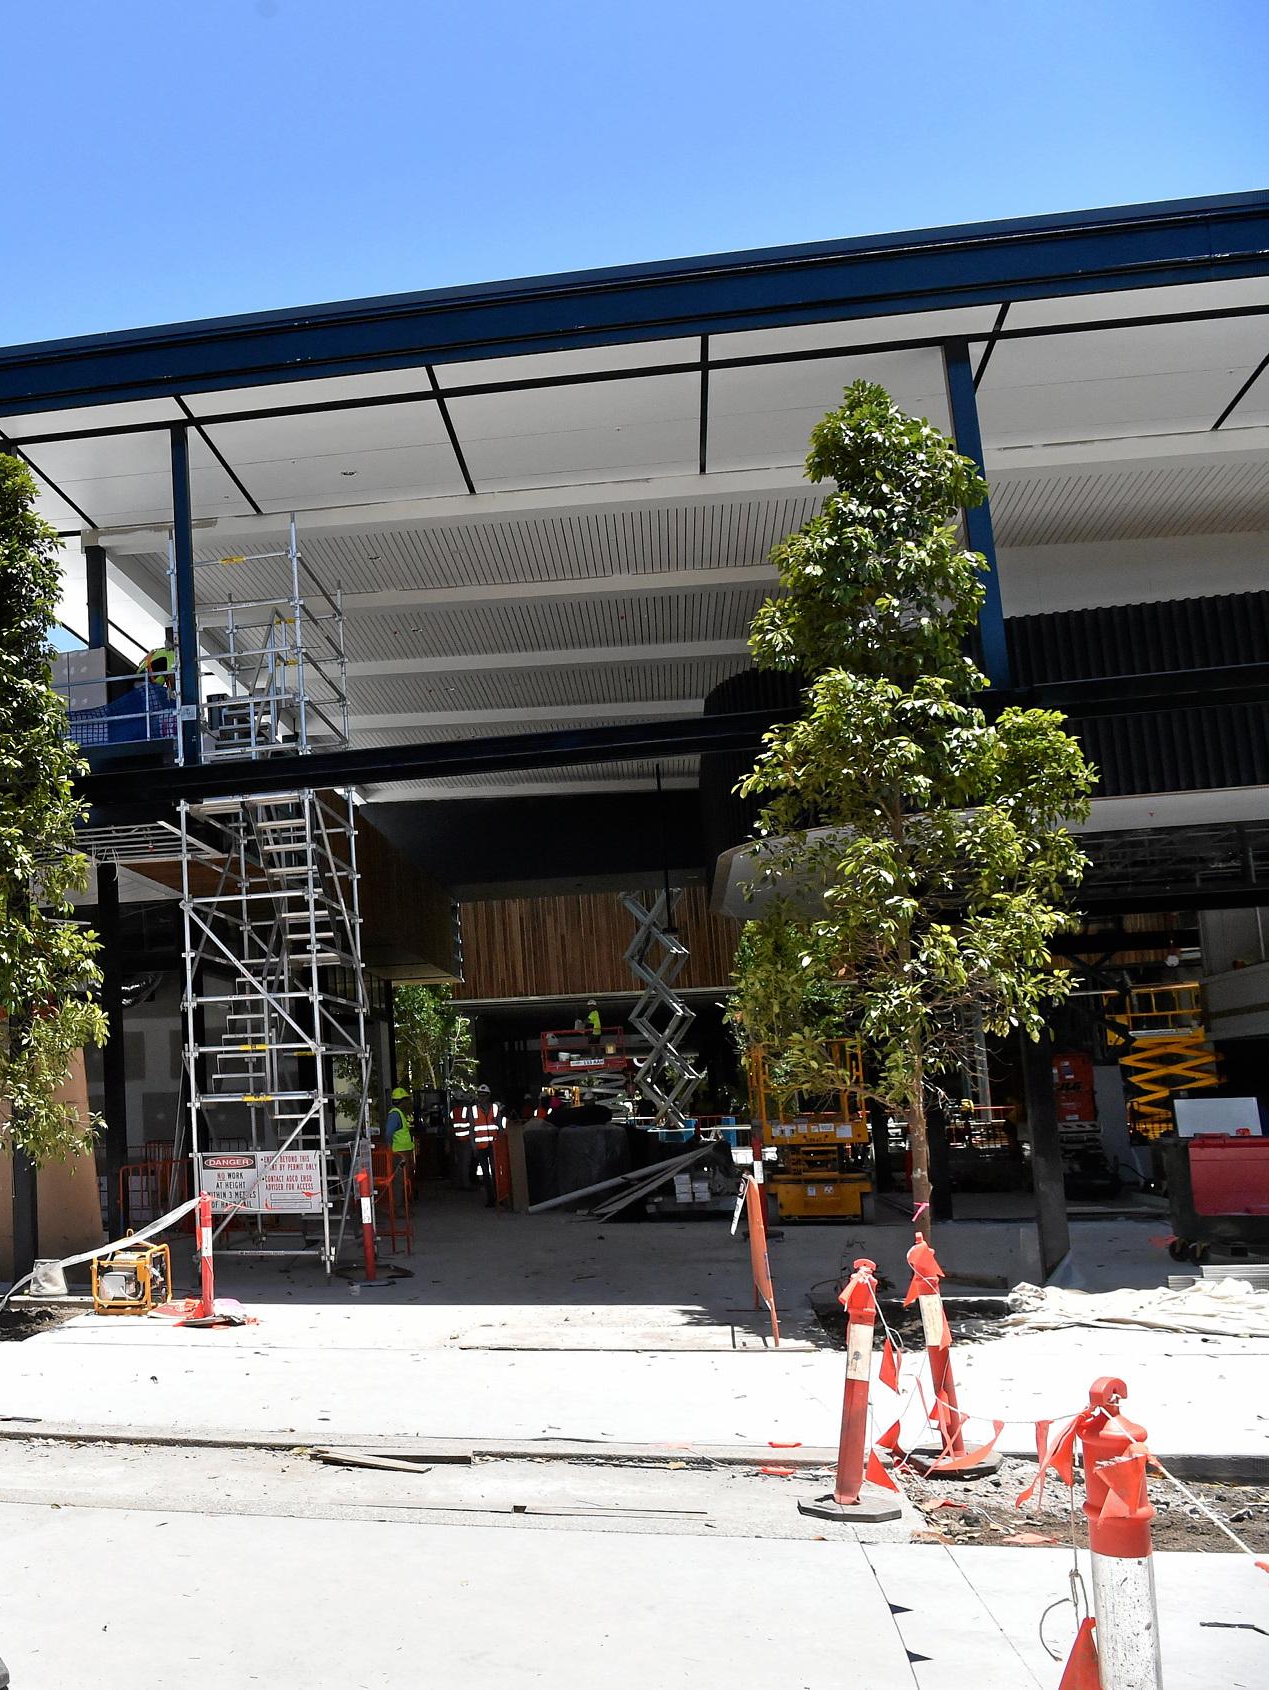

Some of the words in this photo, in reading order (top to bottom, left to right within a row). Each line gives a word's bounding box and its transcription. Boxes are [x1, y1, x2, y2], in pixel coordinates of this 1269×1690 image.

[287, 1163, 304, 1171] PERMIT
[217, 1172, 226, 1180] NO
[227, 1172, 244, 1180] WORK
[265, 1175, 284, 1183] CONTACT
[216, 1182, 223, 1190] AT
[224, 1181, 246, 1189] HEIGHT
[266, 1183, 284, 1191] ADVISER
[286, 1183, 295, 1191] FOR
[229, 1191, 233, 1199] 3
[235, 1191, 257, 1199] METES
[211, 1201, 219, 1209] OF
